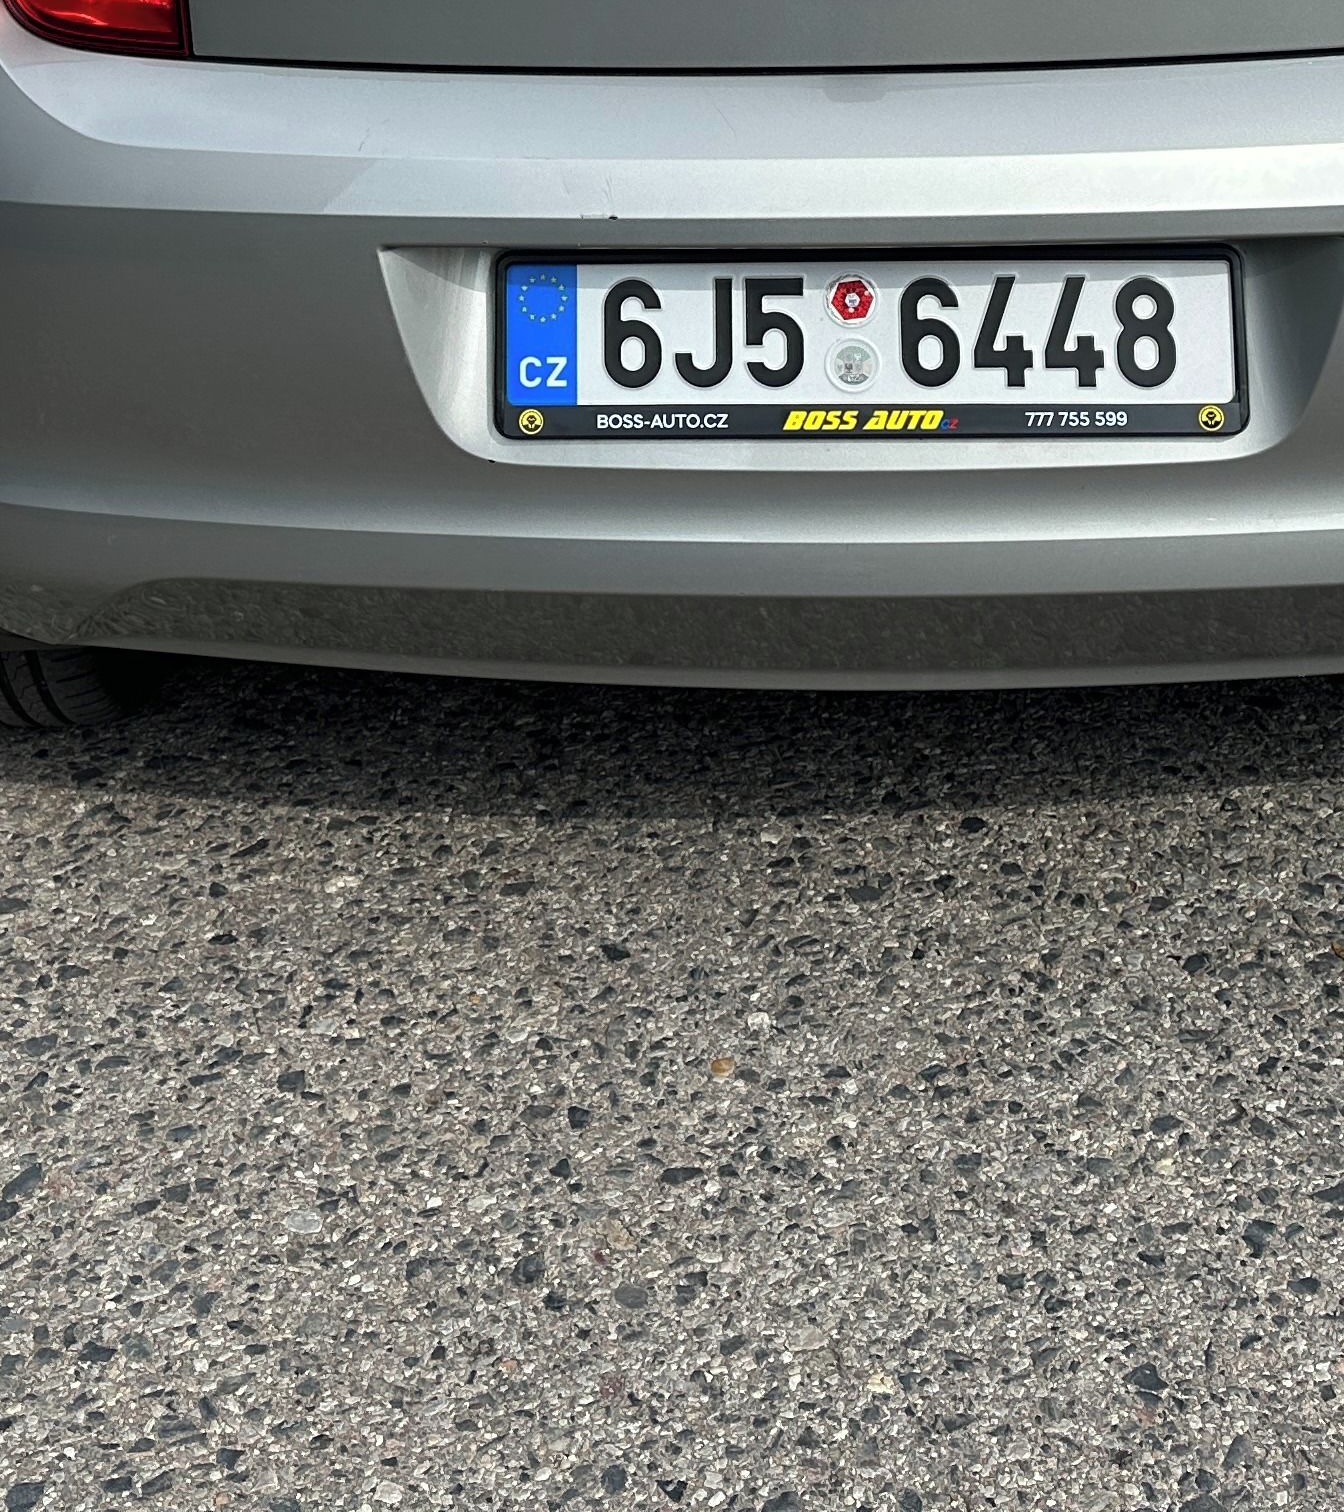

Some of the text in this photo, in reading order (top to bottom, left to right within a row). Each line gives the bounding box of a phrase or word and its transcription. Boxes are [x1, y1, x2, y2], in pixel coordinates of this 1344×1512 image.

[519, 275, 1177, 389] CZ 6J5 6448
[596, 413, 729, 430] BOSS-AUTO.CZ
[782, 409, 860, 431] BOSS
[1024, 411, 1128, 427] 777 755 599
